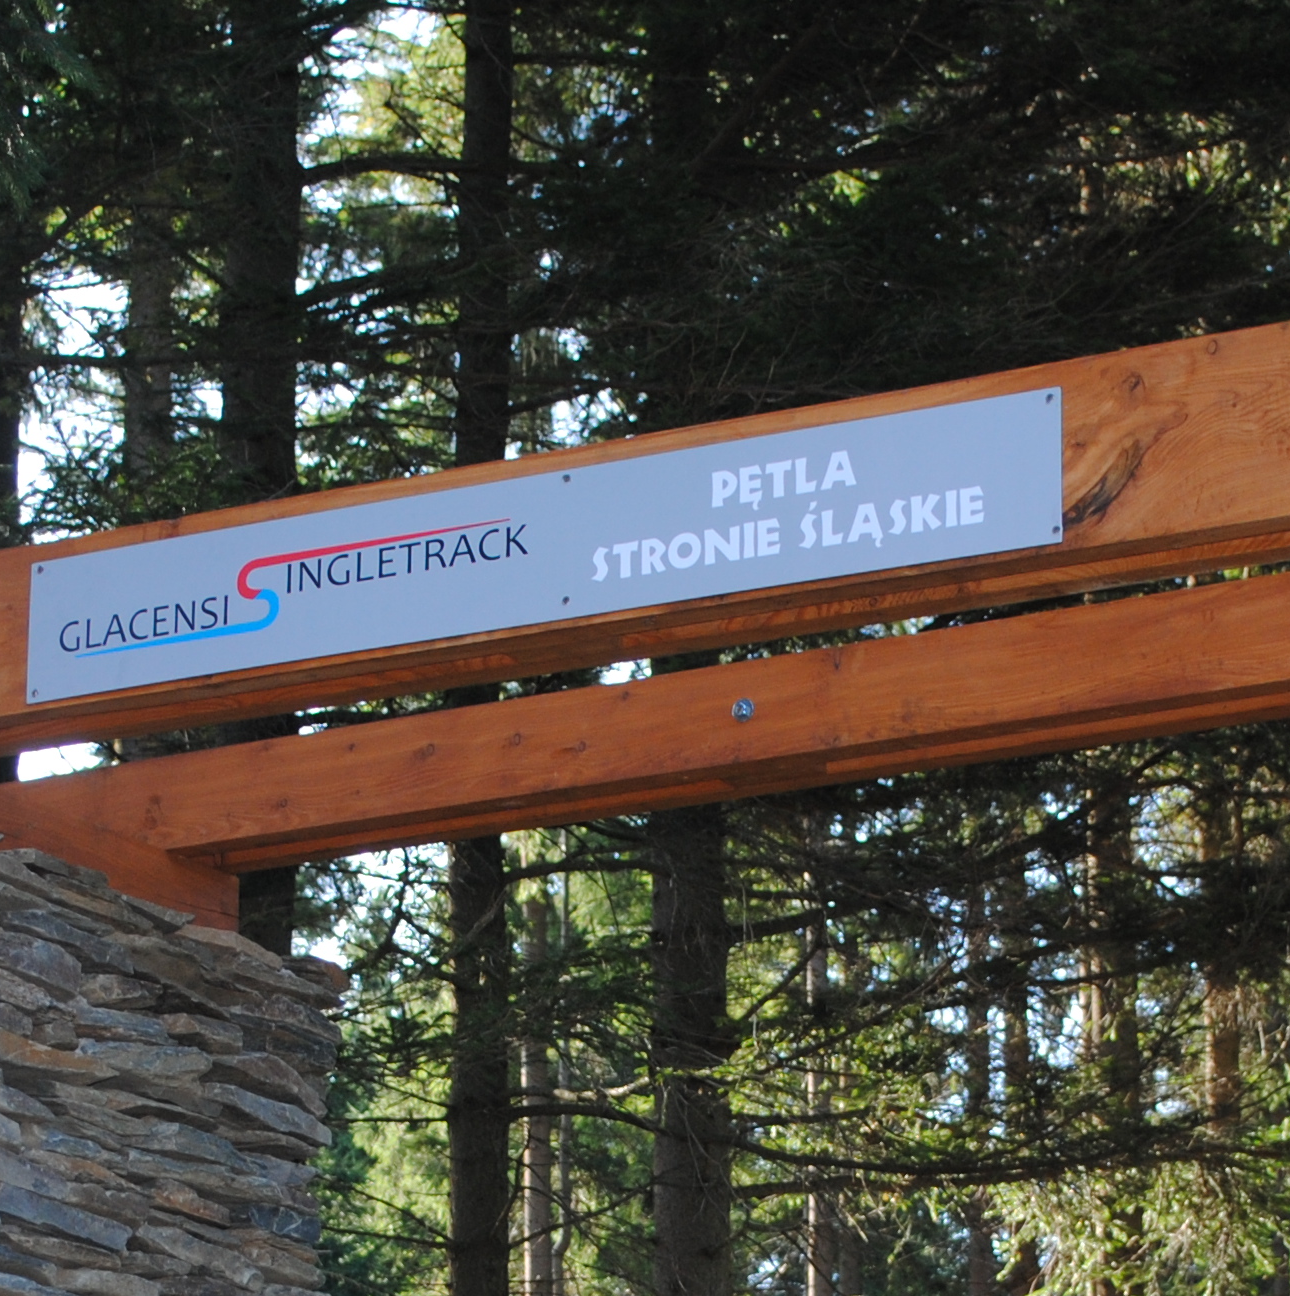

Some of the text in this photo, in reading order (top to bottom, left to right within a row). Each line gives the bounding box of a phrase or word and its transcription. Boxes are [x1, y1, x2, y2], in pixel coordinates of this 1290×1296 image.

[711, 450, 857, 511] PĘTLA
[591, 485, 985, 582] STRONIE ŚLĄSKIE
[59, 595, 229, 653] GLACENSI
